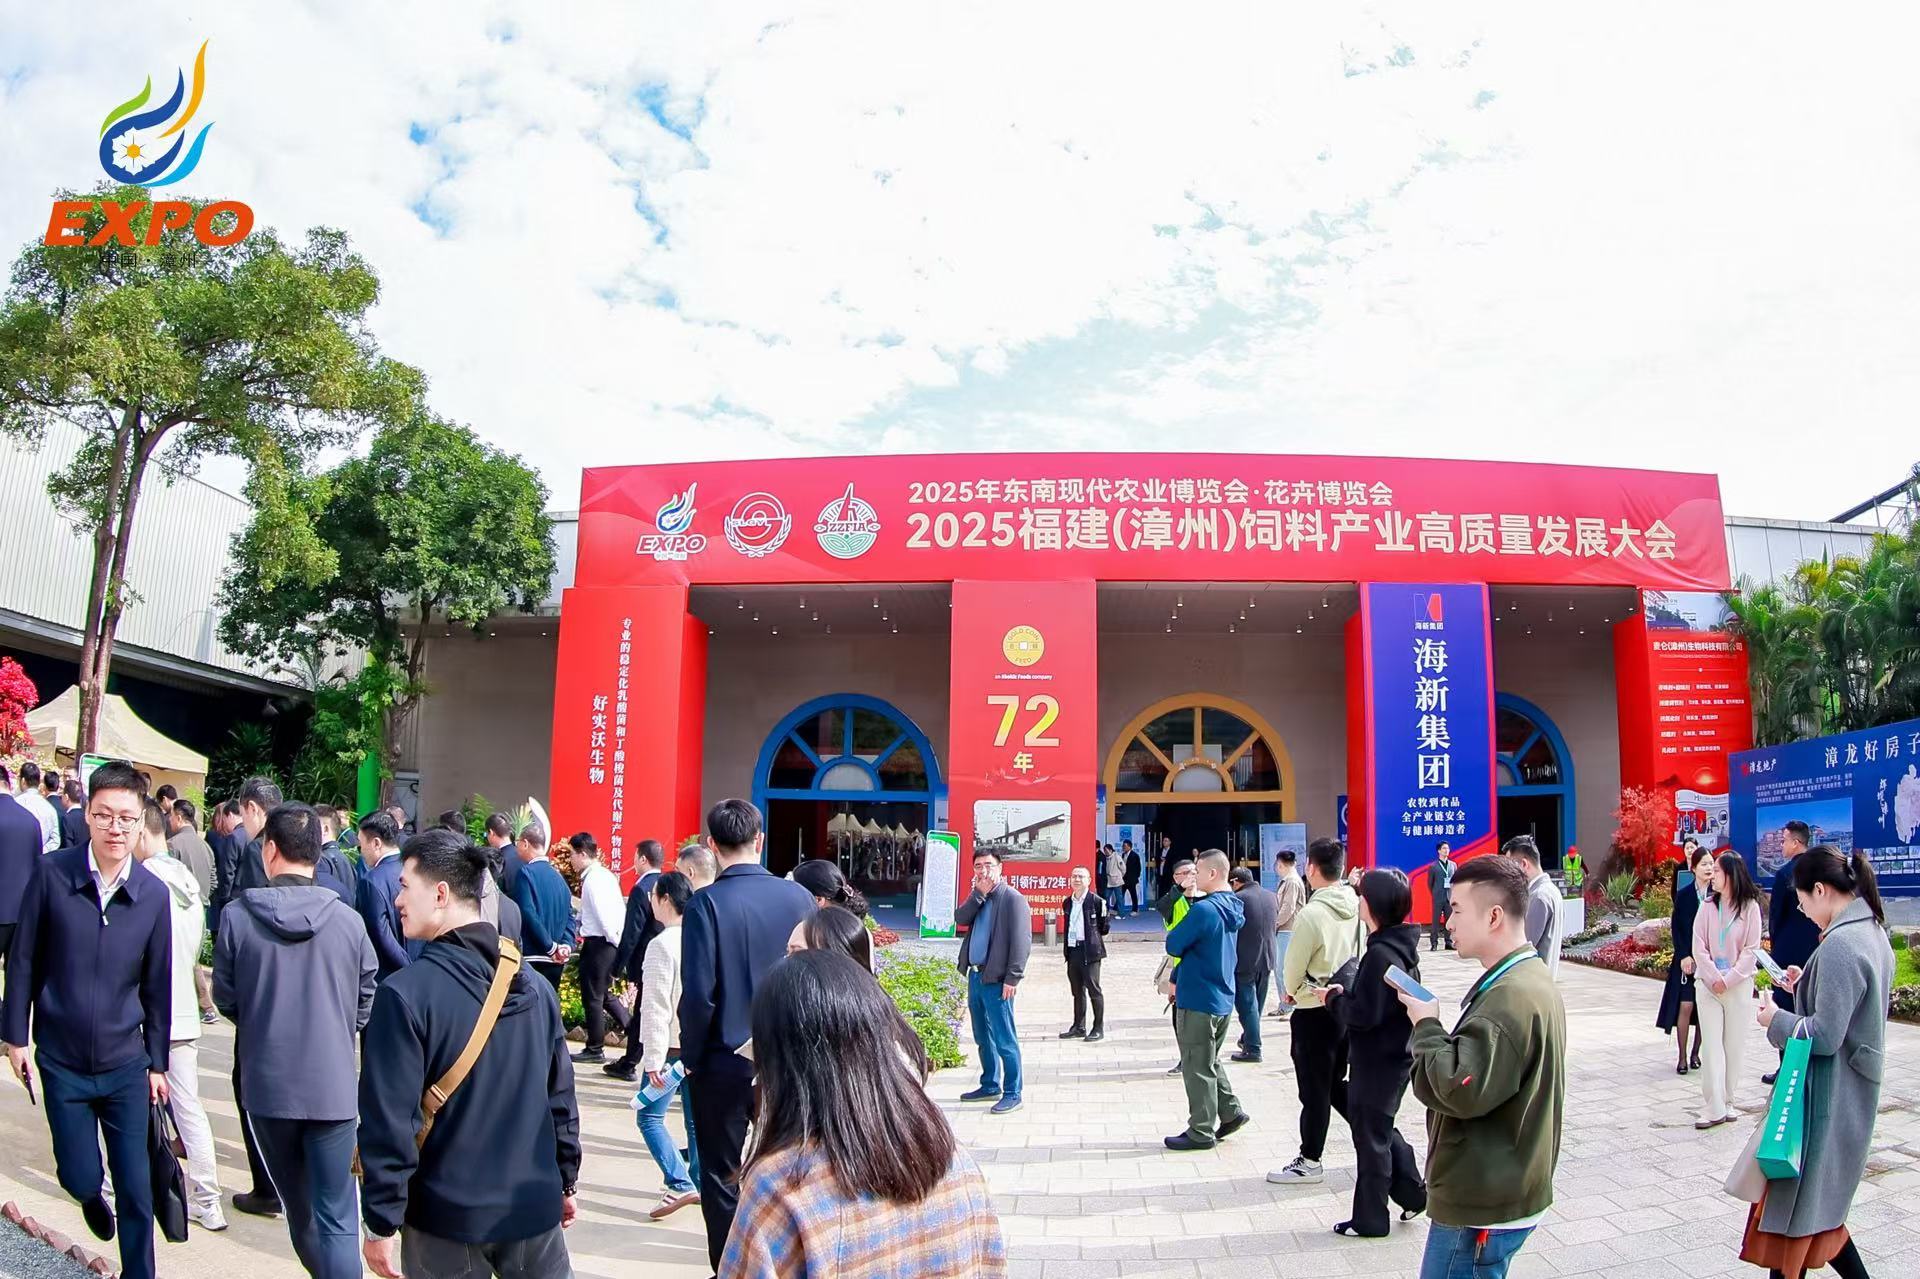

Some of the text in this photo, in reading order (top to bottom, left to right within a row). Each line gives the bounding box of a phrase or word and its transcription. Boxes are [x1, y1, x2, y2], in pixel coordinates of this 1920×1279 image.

[908, 478, 1393, 506] 2025年东南现代农业博览会·花卉博览会
[638, 536, 706, 552] EXPO
[905, 506, 1677, 561] 2025福建(漳州)饲料产业高质量发展大会
[987, 694, 1061, 747] 72
[1412, 637, 1451, 790] 海新集团
[589, 695, 608, 785] 好实沃生物
[1825, 732, 1920, 769] 漳龙好房子
[1013, 751, 1034, 774] 年
[1401, 810, 1465, 822] 全产业链安全
[1407, 797, 1460, 808] 农牧到食品
